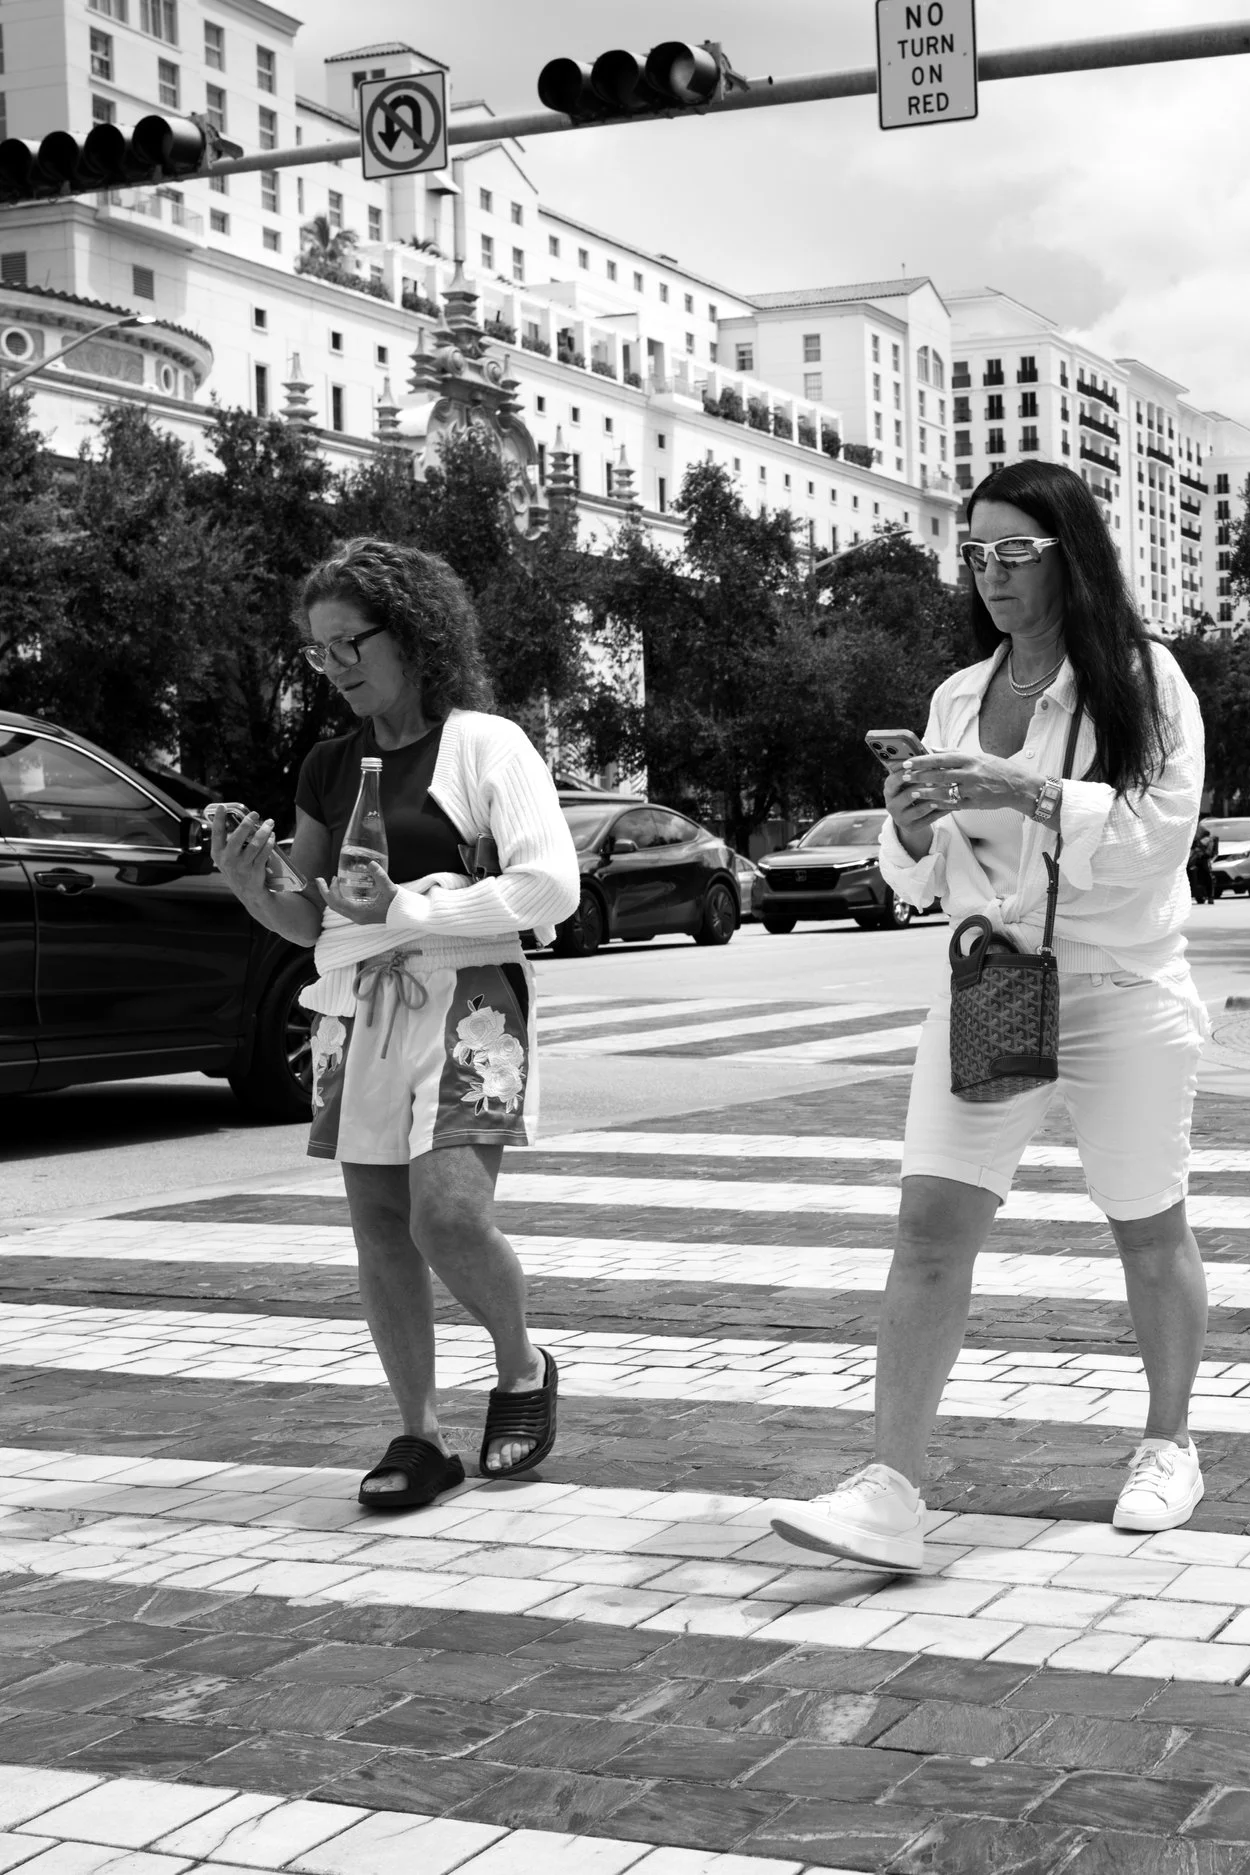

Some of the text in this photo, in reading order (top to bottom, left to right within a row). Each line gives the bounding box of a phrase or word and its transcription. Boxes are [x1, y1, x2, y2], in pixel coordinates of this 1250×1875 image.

[906, 2, 943, 29] NO
[897, 33, 954, 59] TURN
[912, 63, 942, 86] ON
[908, 92, 949, 116] RED
